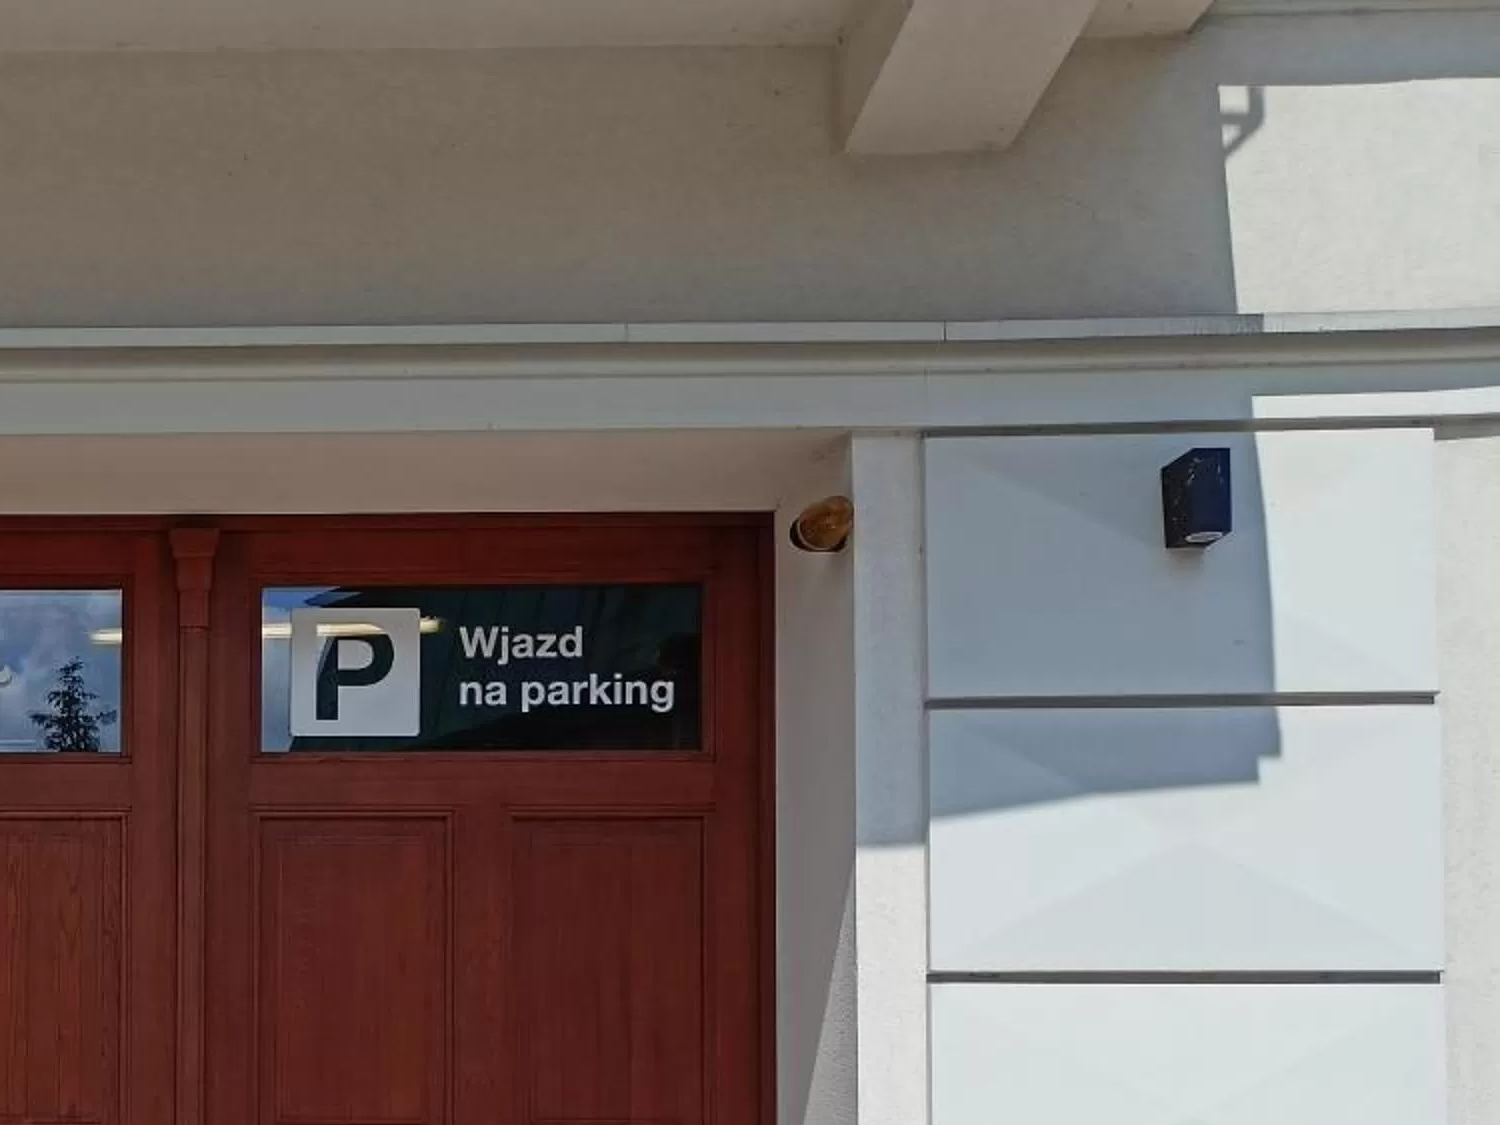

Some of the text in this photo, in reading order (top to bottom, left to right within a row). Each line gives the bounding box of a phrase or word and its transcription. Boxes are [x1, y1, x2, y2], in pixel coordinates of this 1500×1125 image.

[459, 625, 584, 665] Wjazd
[315, 623, 395, 721] P
[459, 673, 676, 713] na parking
